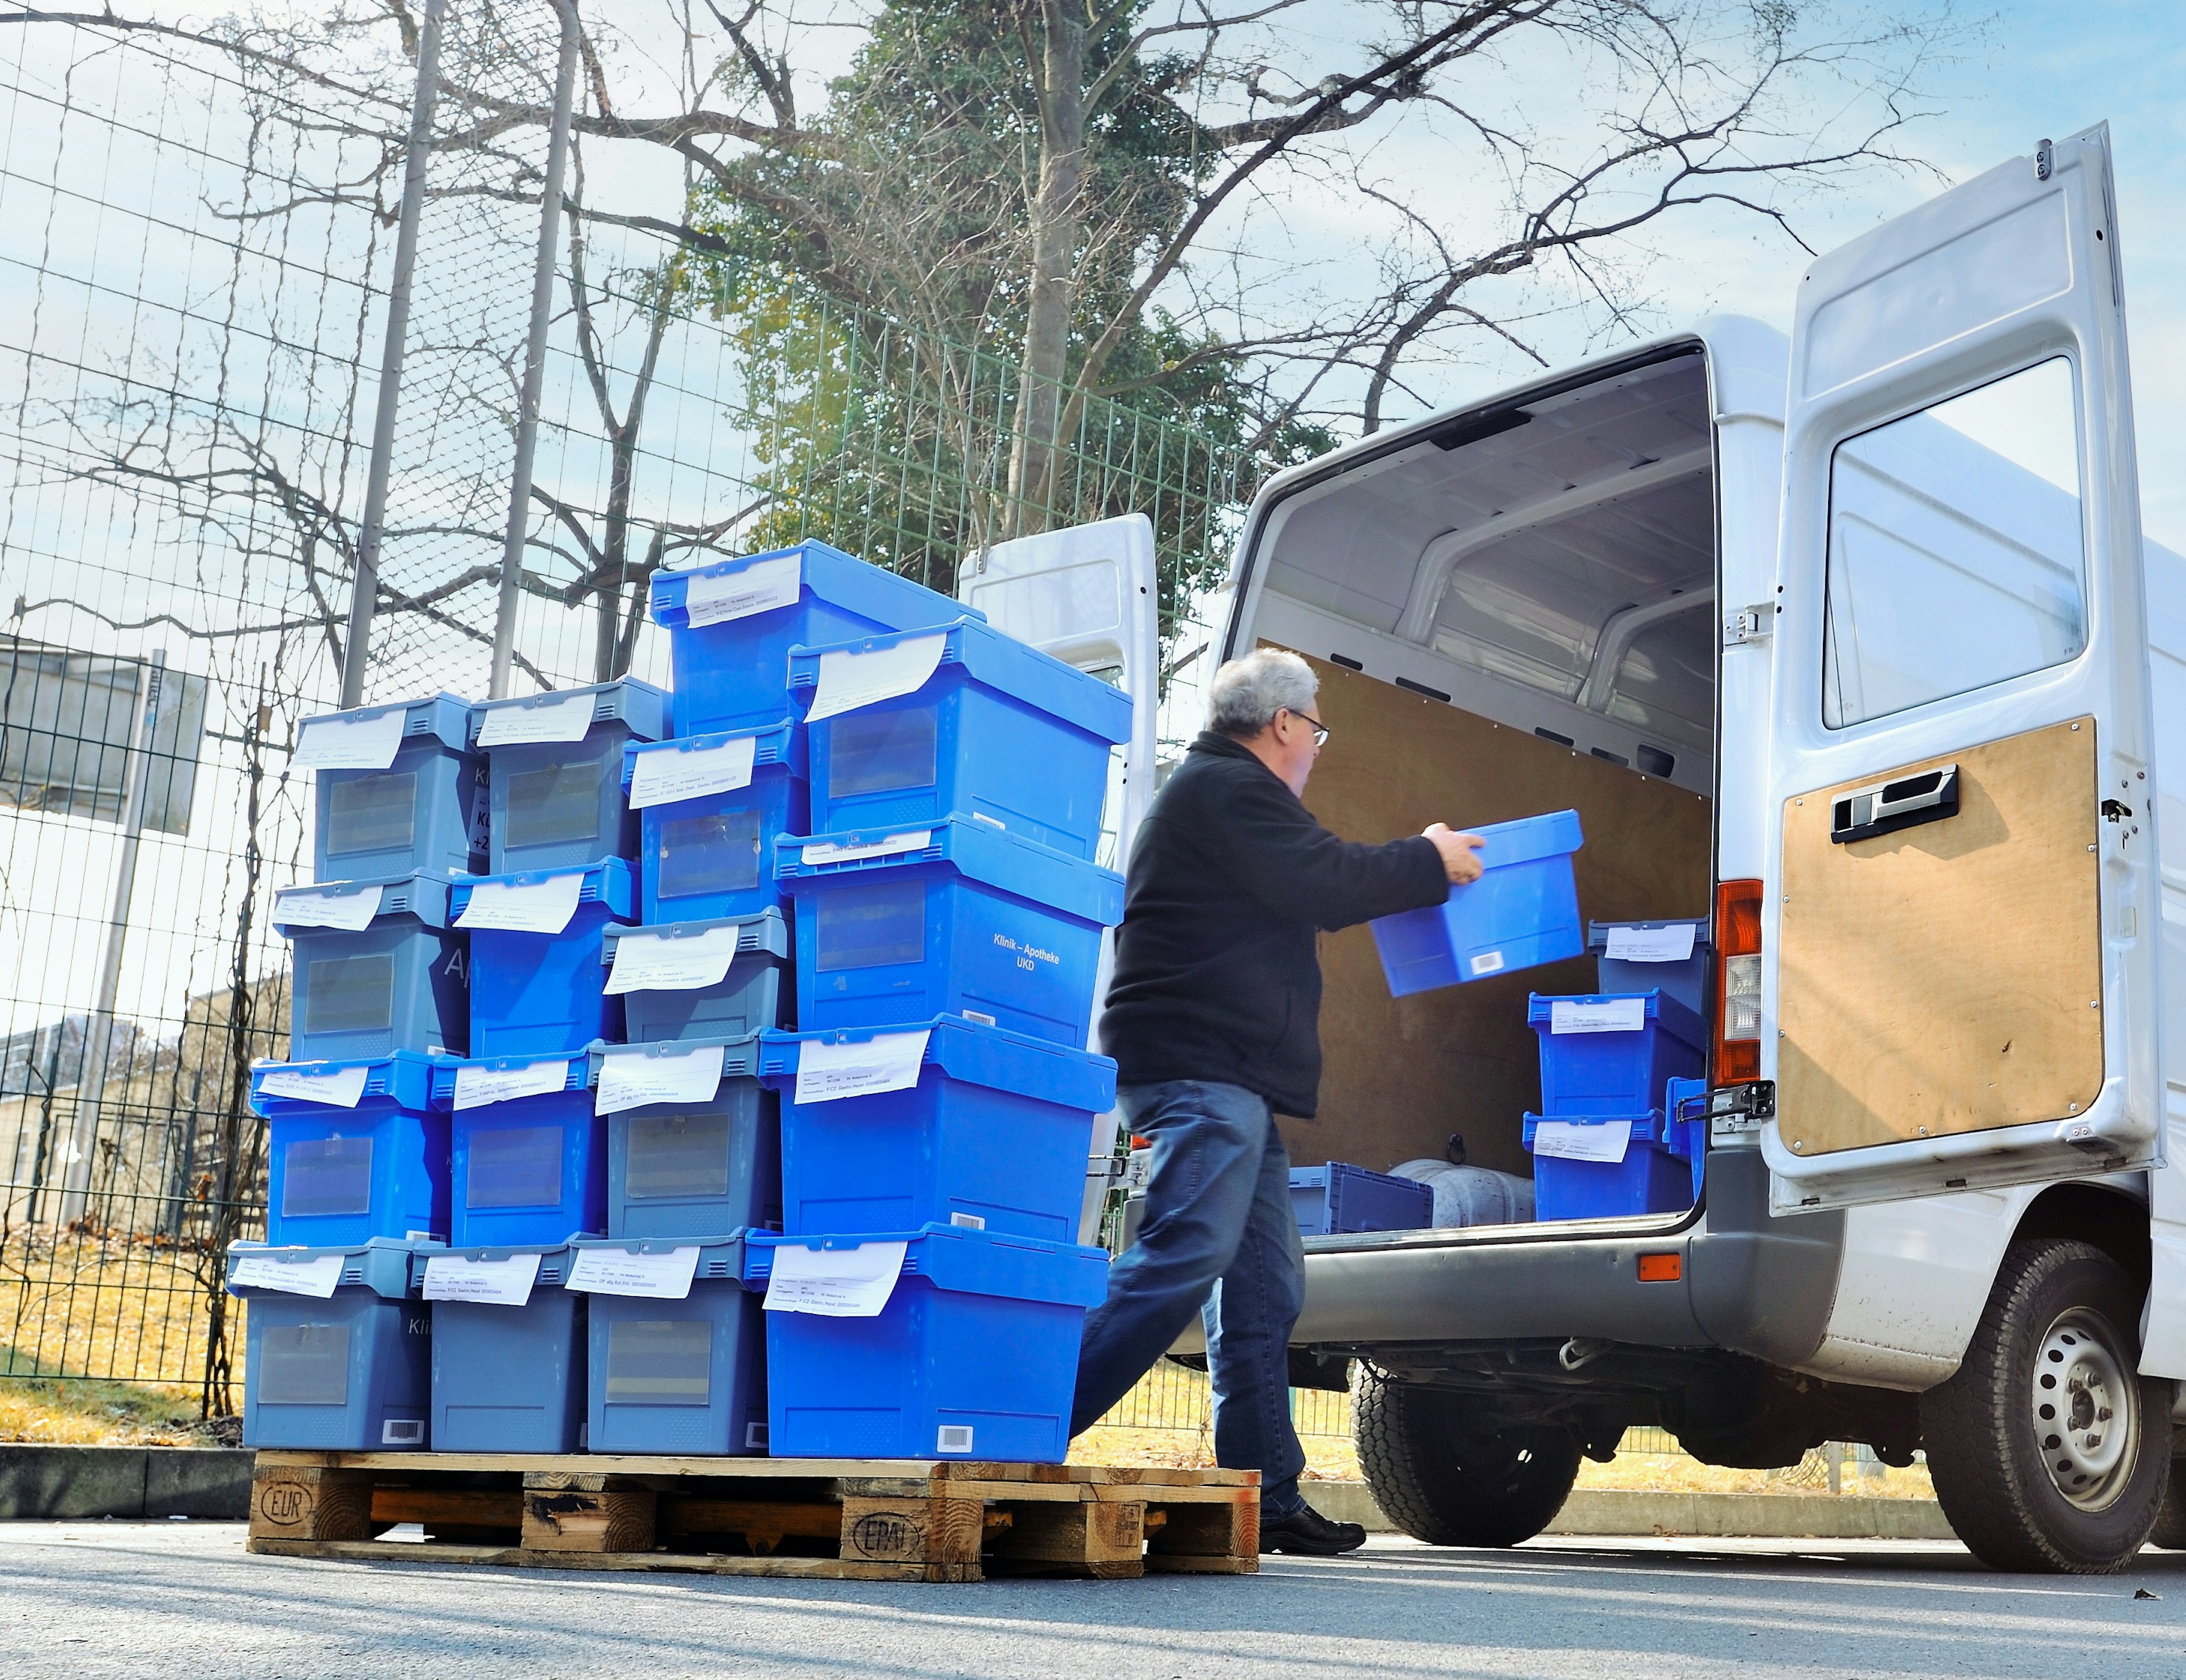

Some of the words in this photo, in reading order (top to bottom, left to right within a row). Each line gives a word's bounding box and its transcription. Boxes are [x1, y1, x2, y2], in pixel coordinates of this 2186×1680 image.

[993, 933, 1016, 950] Klinik
[1023, 944, 1060, 965] Apotheke
[1016, 956, 1034, 971] UKD
[271, 1490, 302, 1517] EUR
